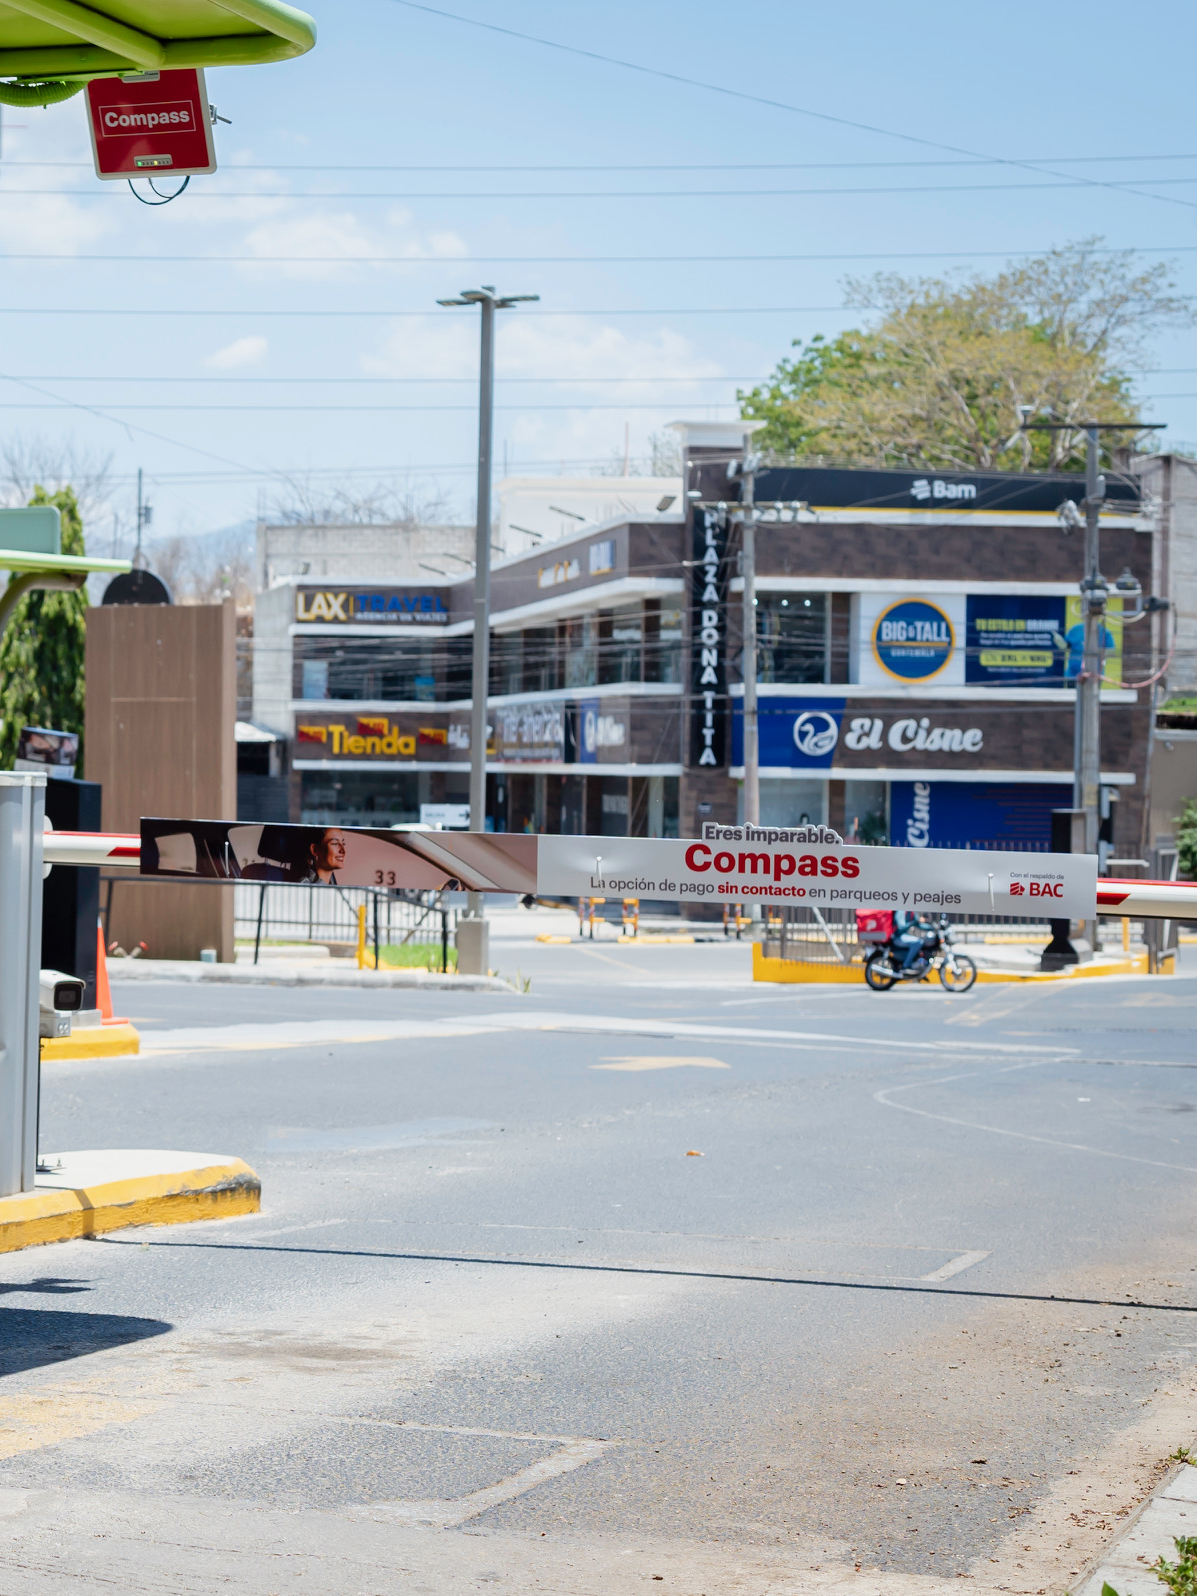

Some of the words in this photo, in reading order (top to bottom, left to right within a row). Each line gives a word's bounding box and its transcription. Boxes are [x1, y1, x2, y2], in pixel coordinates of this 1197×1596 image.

[104, 110, 190, 128] Compass
[932, 480, 977, 500] Bam
[296, 591, 349, 622] LAX
[356, 594, 448, 613] TRAVEL
[700, 609, 719, 685] DONA
[328, 724, 416, 756] Tienda
[698, 690, 718, 766] TITA
[844, 717, 884, 751] El
[887, 717, 984, 753] Cisne
[906, 782, 931, 848] Cisne
[705, 825, 743, 842] Eres
[745, 825, 840, 846] imparable.
[684, 843, 861, 882] Compass
[1030, 873, 1056, 881] respaldo
[590, 876, 605, 889] La
[608, 877, 655, 892] opción
[658, 879, 676, 892] de
[679, 882, 715, 896] pago
[717, 883, 739, 895] sin
[741, 885, 806, 897] contacto
[808, 887, 826, 898] en
[830, 889, 898, 905] parqueos
[901, 892, 911, 905] y
[913, 891, 962, 906] peajes
[1029, 882, 1064, 898] BAC
